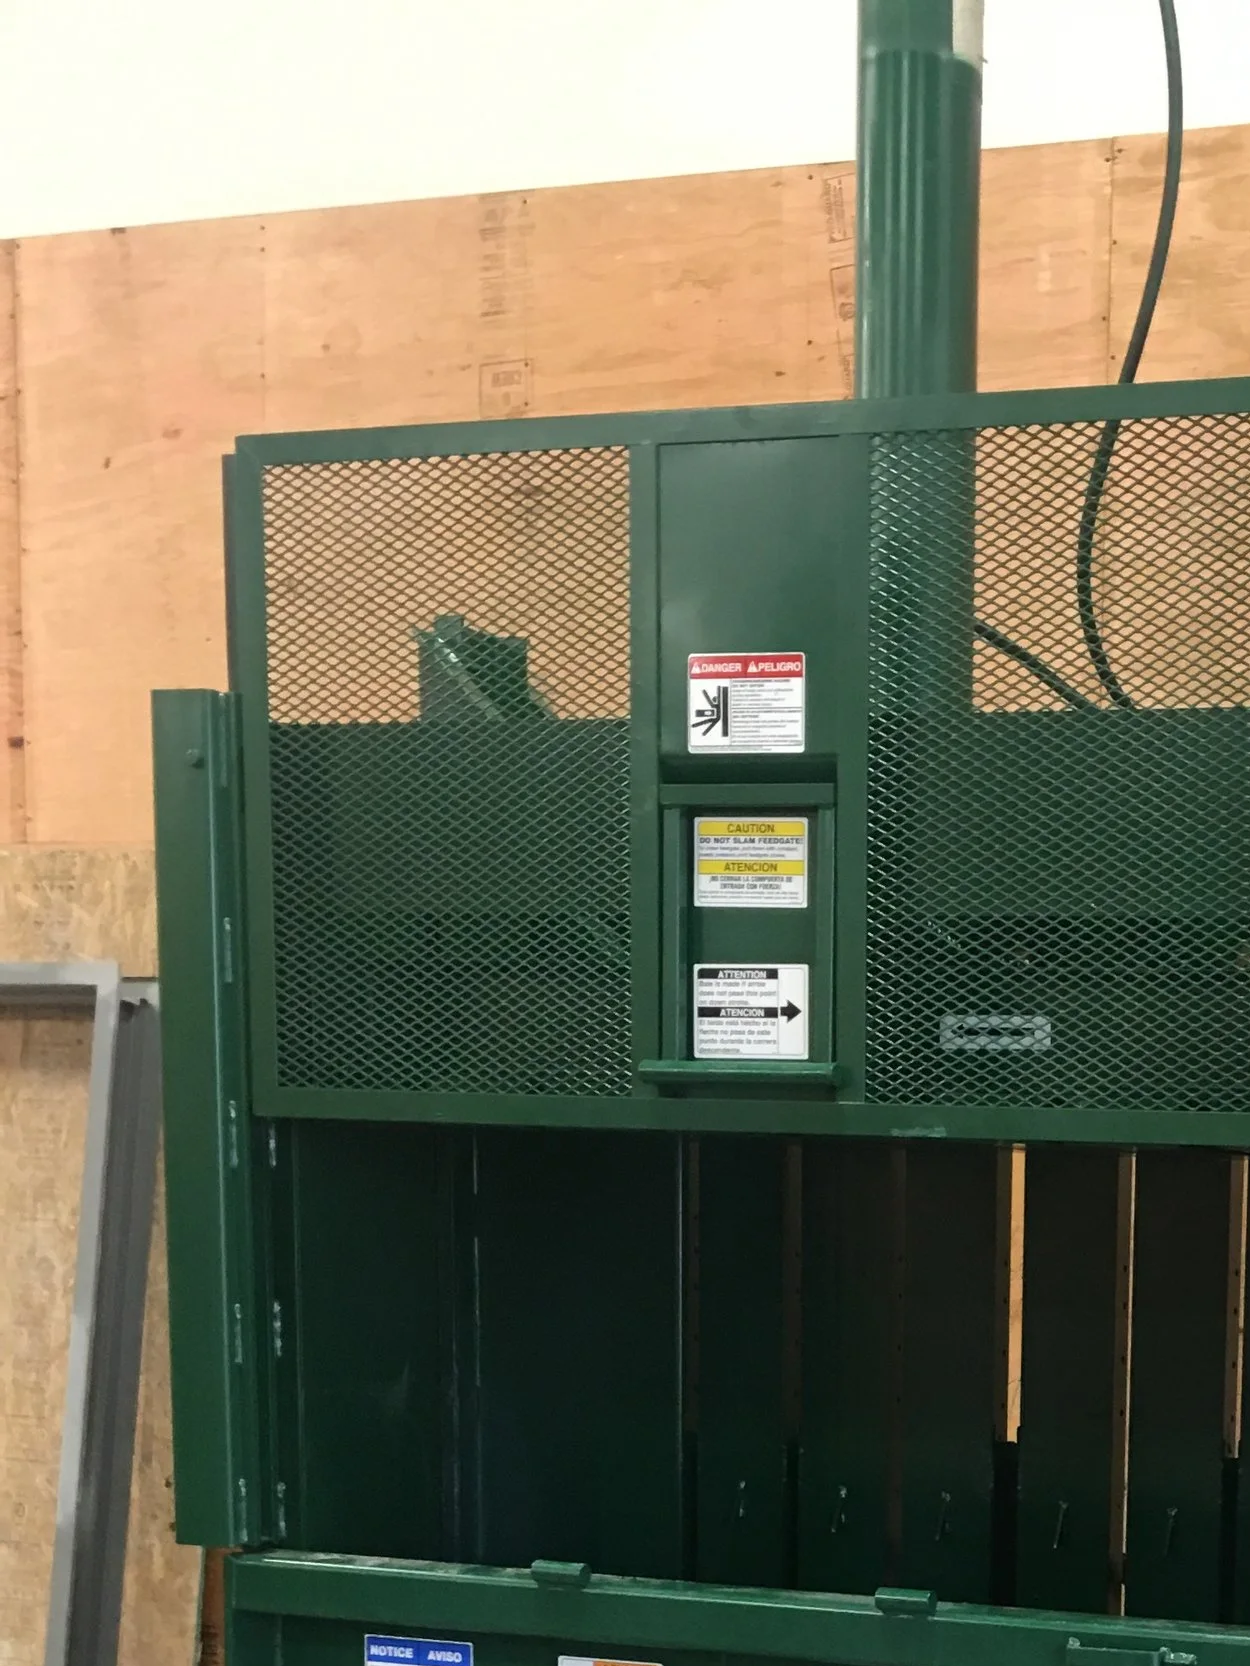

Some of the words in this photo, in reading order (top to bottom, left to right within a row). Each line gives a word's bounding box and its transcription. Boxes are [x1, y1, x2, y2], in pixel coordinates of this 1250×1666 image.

[701, 663, 742, 672] DANGER
[758, 662, 801, 672] PELIGRO
[727, 824, 775, 833] CAUTION
[724, 863, 778, 872] ATENCION
[718, 970, 766, 979] ATTENTION
[720, 1009, 764, 1017] ATENCION
[370, 1645, 414, 1658] NOTICE
[427, 1650, 462, 1662] AVISO
